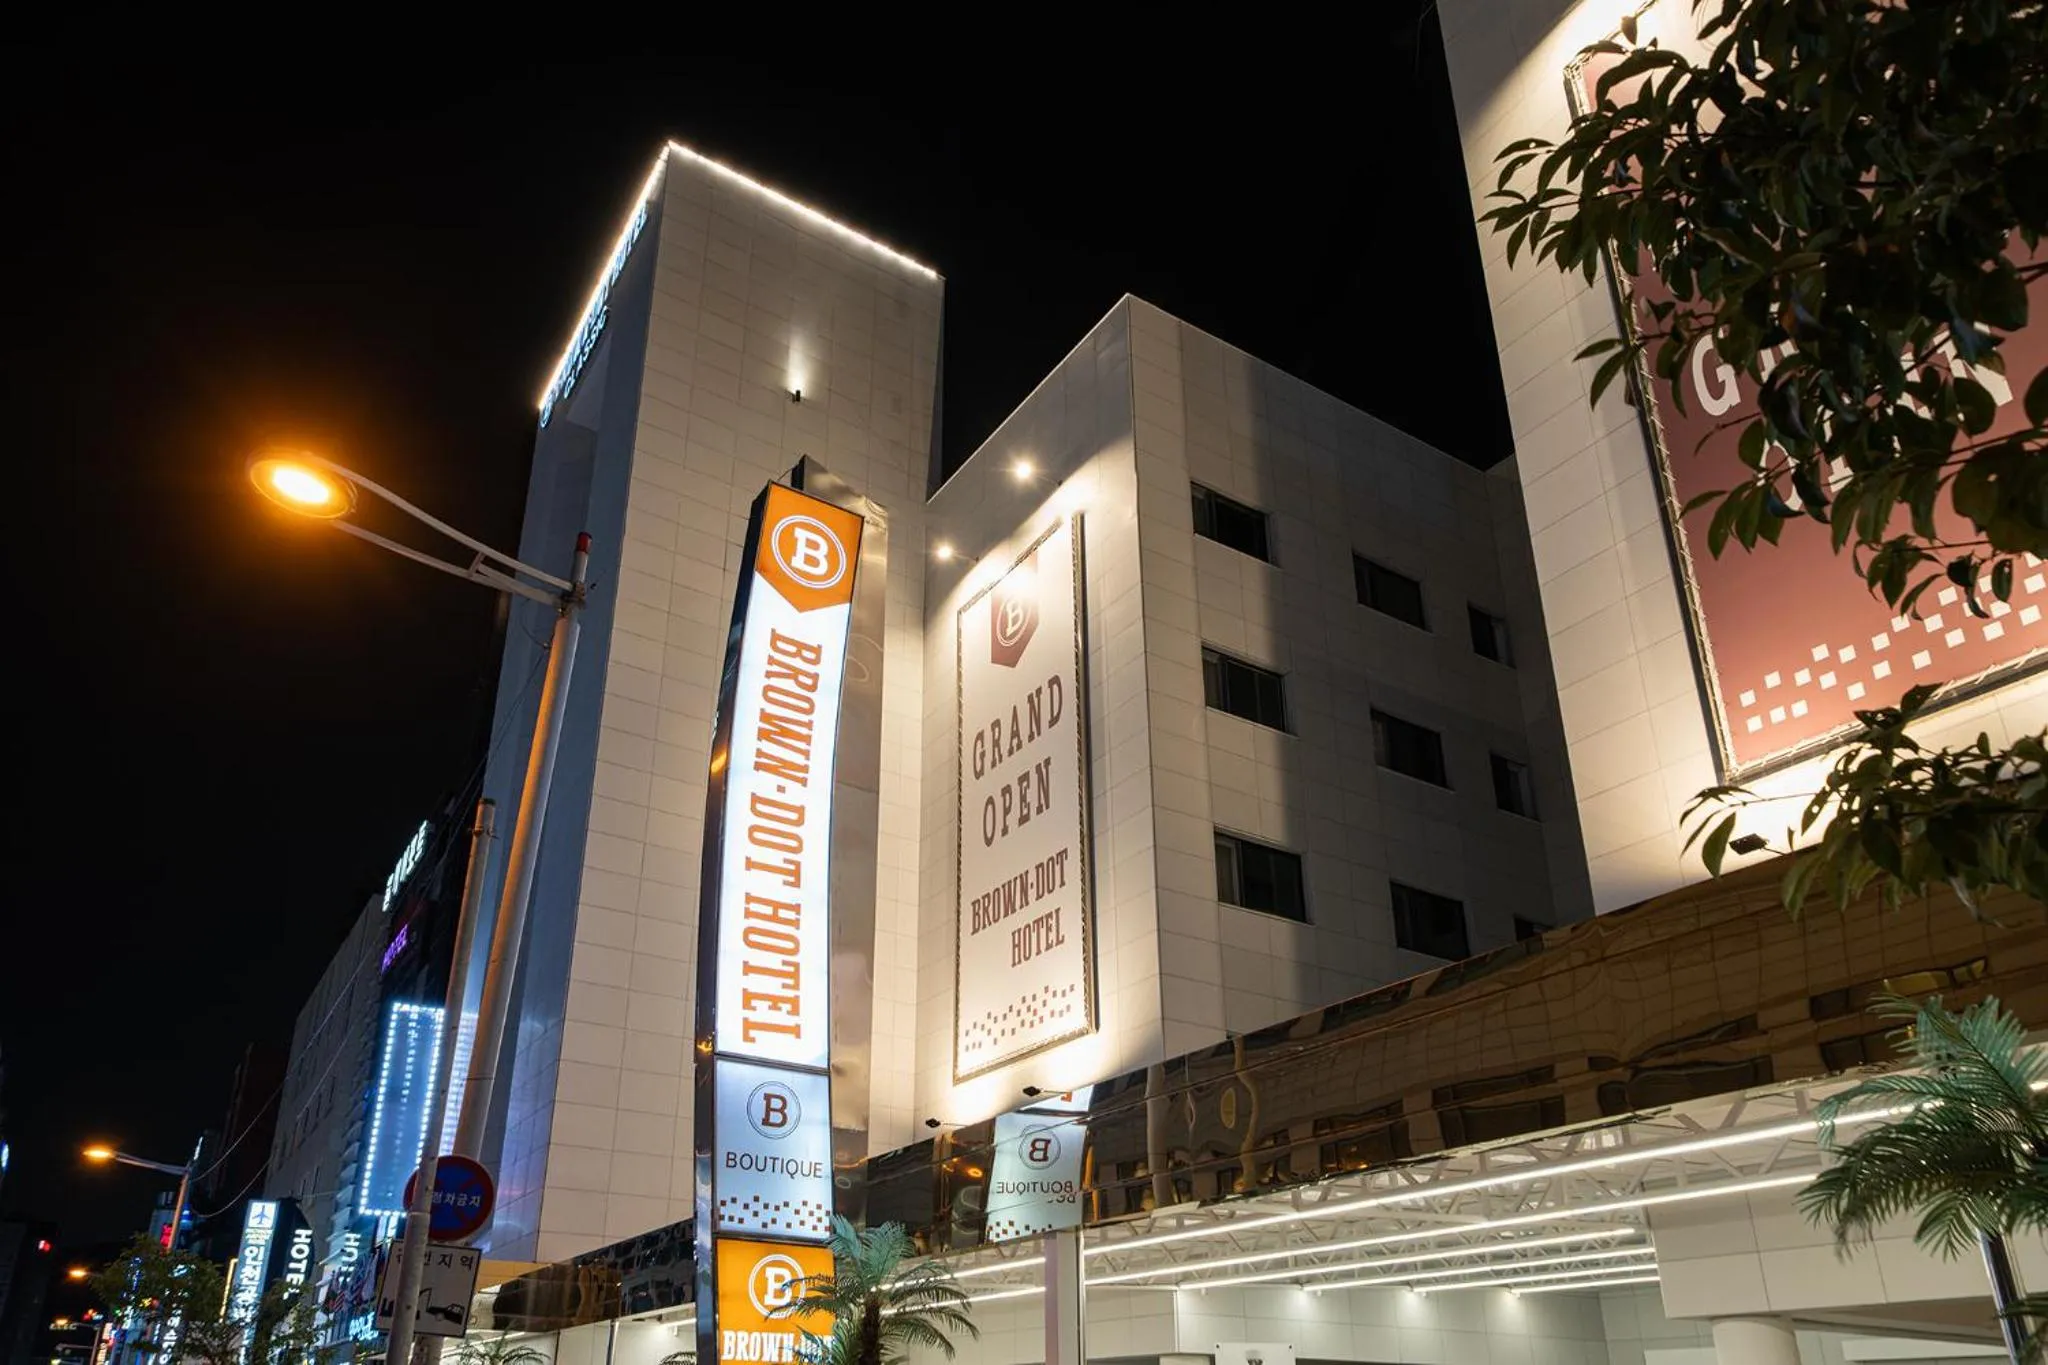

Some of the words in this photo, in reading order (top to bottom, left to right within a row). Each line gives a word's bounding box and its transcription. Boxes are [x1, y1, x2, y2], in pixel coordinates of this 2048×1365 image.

[791, 526, 829, 576] B
[972, 674, 1063, 781] GRAND
[982, 756, 1052, 848] OPEN
[1011, 907, 1065, 968] HOTEL
[742, 892, 802, 1044] HOTEL
[761, 1093, 789, 1128] B
[725, 1151, 824, 1179] BOUTIQUE
[764, 1266, 792, 1305] B
